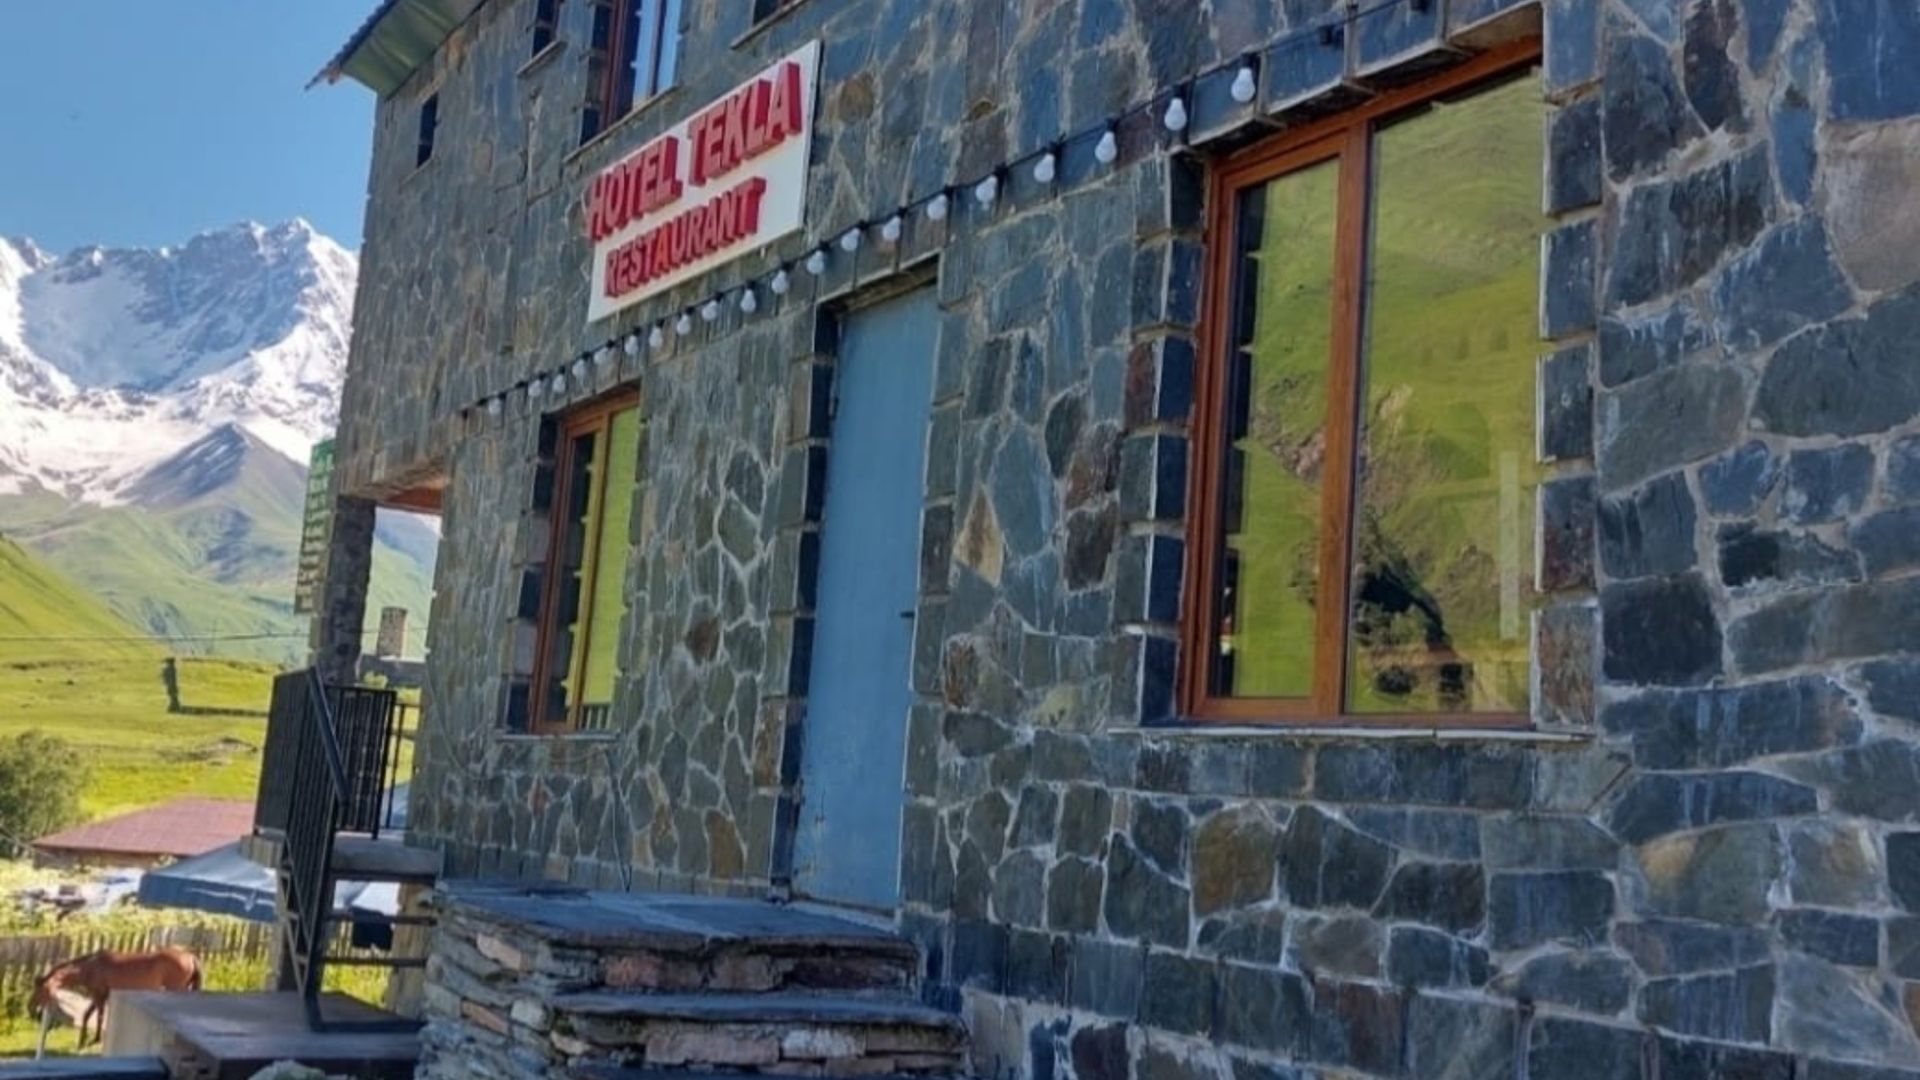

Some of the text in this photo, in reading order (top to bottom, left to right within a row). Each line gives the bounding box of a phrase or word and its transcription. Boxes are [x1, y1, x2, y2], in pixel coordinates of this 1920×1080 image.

[588, 61, 802, 242] HOTEL TEKLA
[605, 176, 767, 298] RESTAURANT
